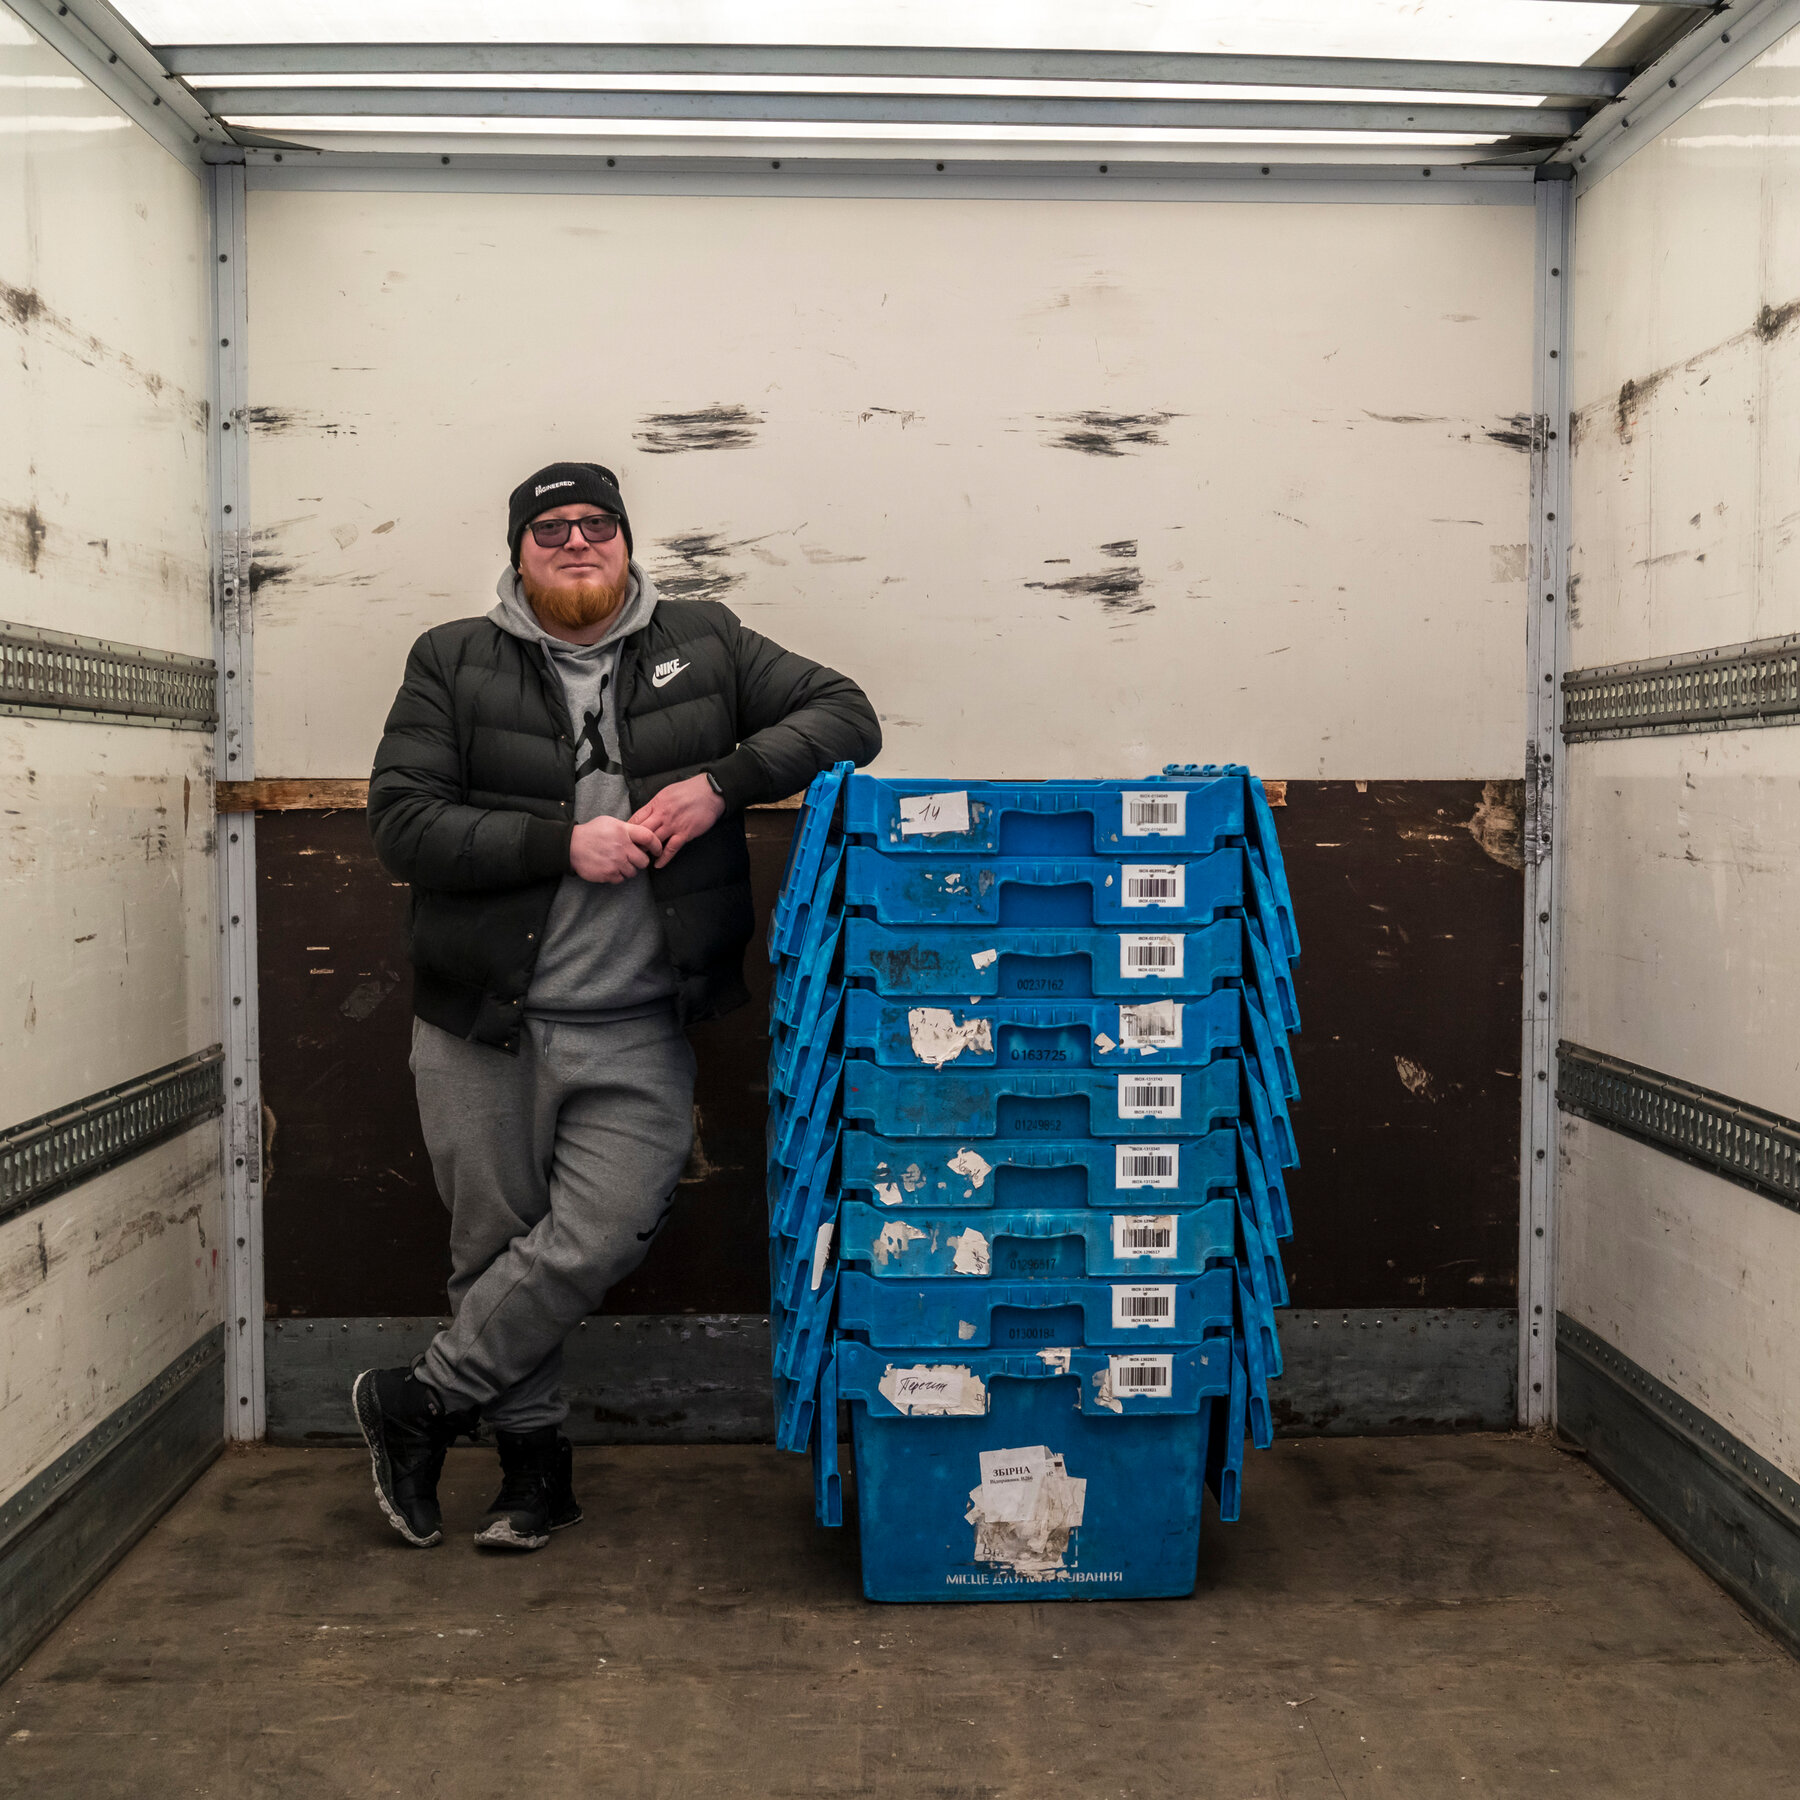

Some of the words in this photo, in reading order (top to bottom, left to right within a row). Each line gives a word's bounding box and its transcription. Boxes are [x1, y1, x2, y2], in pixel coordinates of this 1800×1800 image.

[655, 658, 680, 677] NIKE
[918, 803, 941, 821] 14
[1016, 978, 1064, 990] 00237162
[1011, 1049, 1067, 1061] 0163725
[1008, 1327, 1055, 1339] 01300184
[992, 1466, 1031, 1477] ЗБІРНА
[946, 1574, 990, 1585] МІСЦЕ
[992, 1571, 1024, 1585] ДЛЯ
